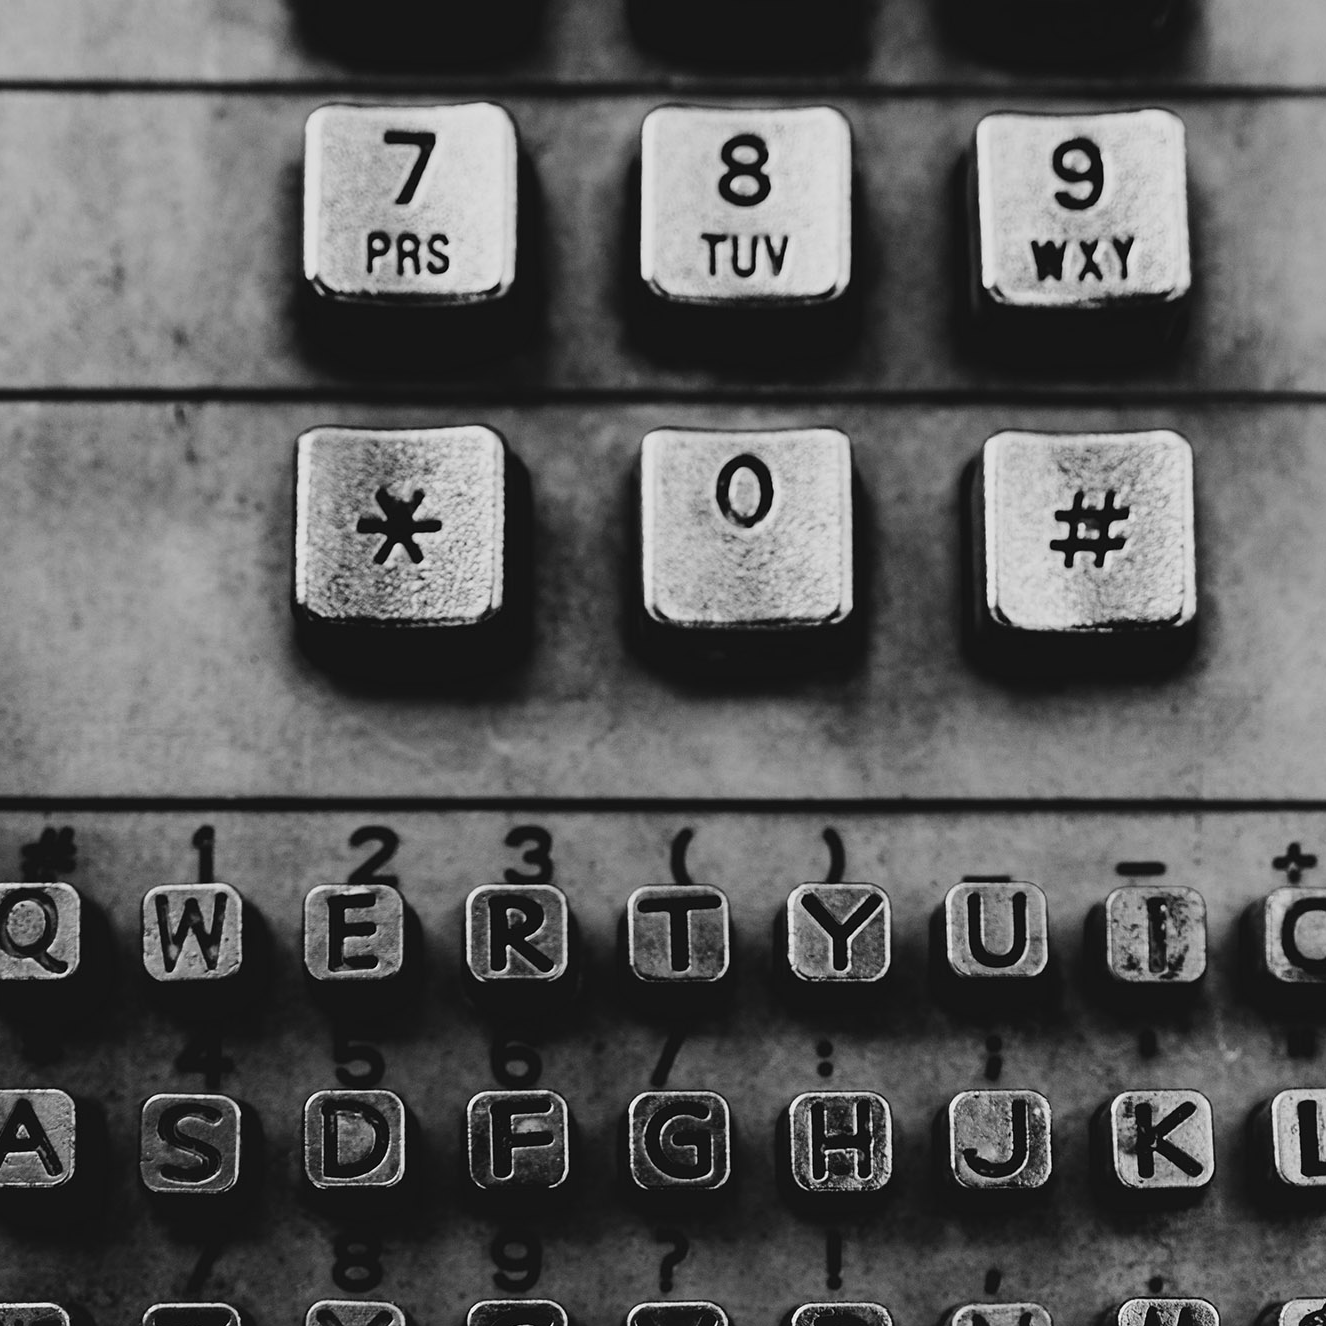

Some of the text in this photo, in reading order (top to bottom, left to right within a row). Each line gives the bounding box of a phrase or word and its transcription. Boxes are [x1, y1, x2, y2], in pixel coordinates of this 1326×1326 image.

[385, 132, 436, 207] 7
[717, 132, 772, 208] 8
[1052, 136, 1104, 211] 9
[364, 232, 451, 278] PRS
[701, 233, 789, 279] TUV
[1030, 235, 1136, 283] WXY
[717, 454, 773, 529] 0
[1049, 489, 1129, 570] #
[192, 825, 215, 883] 1
[349, 826, 400, 886] 2
[503, 826, 553, 884] 3
[155, 892, 227, 972] W
[327, 894, 378, 972] E
[489, 895, 555, 973] R
[637, 896, 722, 971] T
[801, 894, 883, 970] Y
[968, 892, 1027, 968] U
[1148, 896, 1167, 973] I
[176, 1033, 234, 1089] 4
[332, 1033, 385, 1088] 5
[491, 1034, 543, 1088] 6
[157, 1104, 223, 1182] S
[321, 1099, 389, 1178] D
[491, 1101, 553, 1178] F
[645, 1101, 711, 1179] G
[811, 1101, 871, 1180] H
[962, 1100, 1026, 1178] J
[1135, 1101, 1203, 1178] K
[332, 1230, 384, 1293] 8
[491, 1230, 543, 1293] 9
